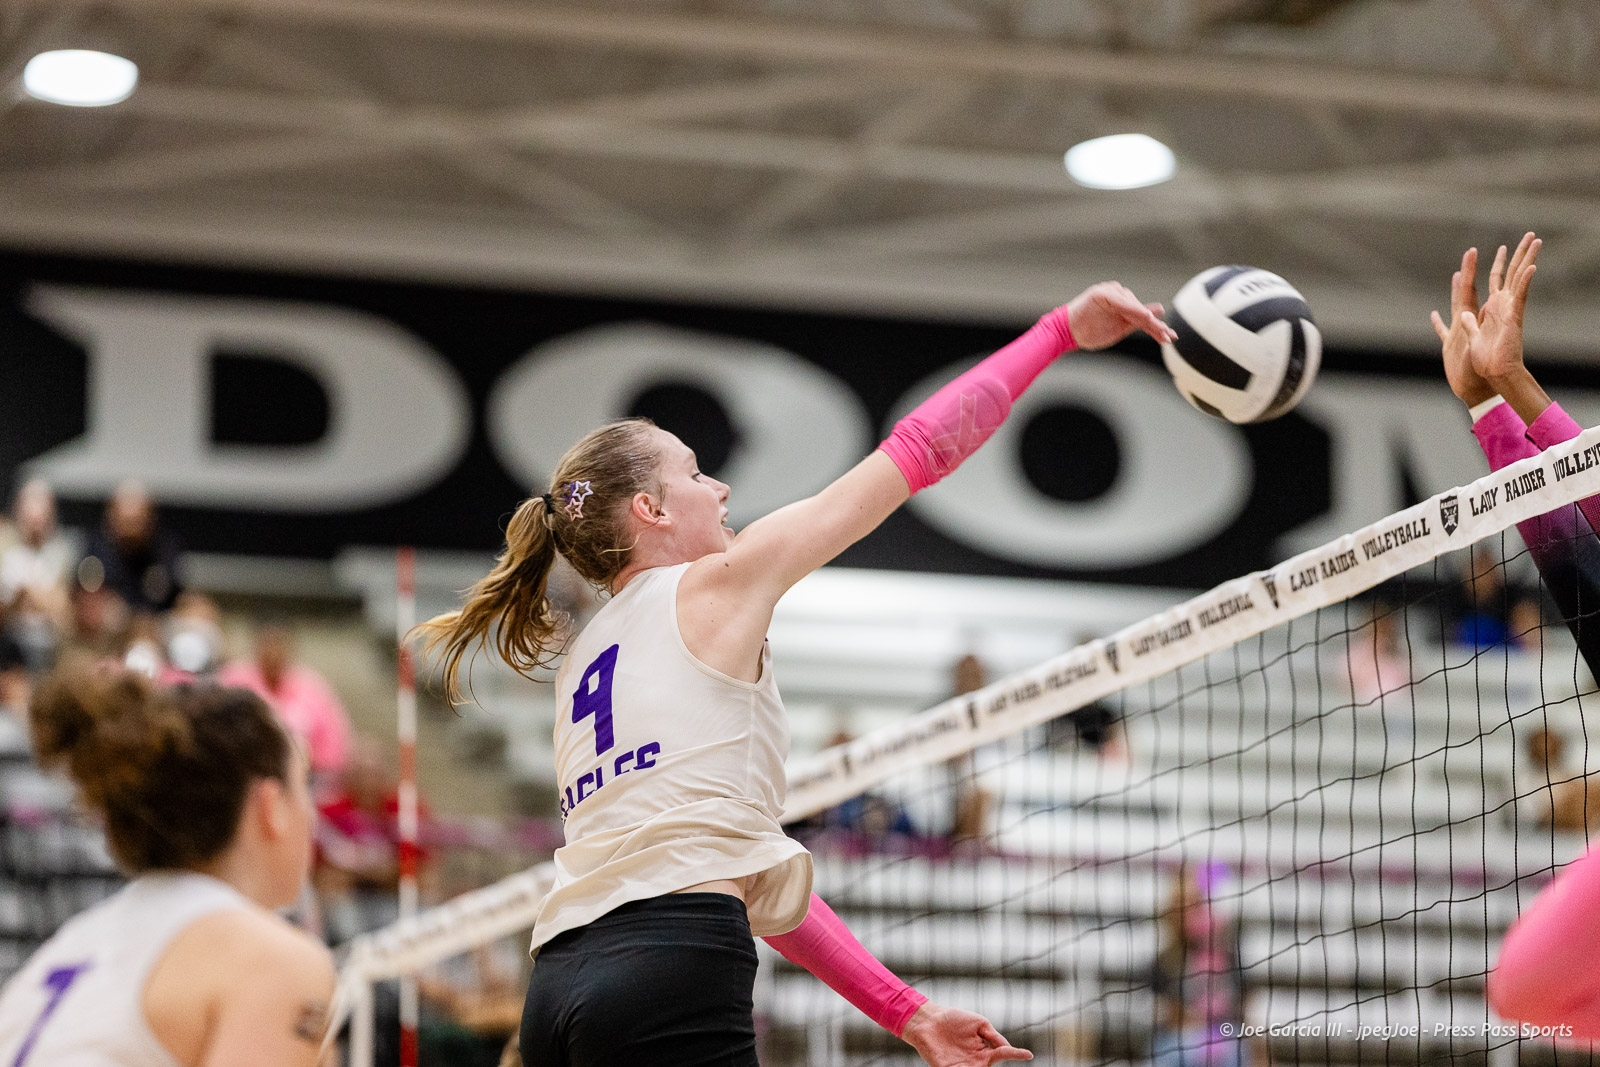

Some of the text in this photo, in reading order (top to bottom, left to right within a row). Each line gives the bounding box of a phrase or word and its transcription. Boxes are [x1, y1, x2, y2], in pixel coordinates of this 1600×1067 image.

[1469, 442, 1600, 517] LADY RAIDER VOLLEY
[1289, 517, 1431, 593] LADY RAIDER VOLLEYBALL
[572, 643, 620, 757] 9
[561, 741, 661, 826] AGLES
